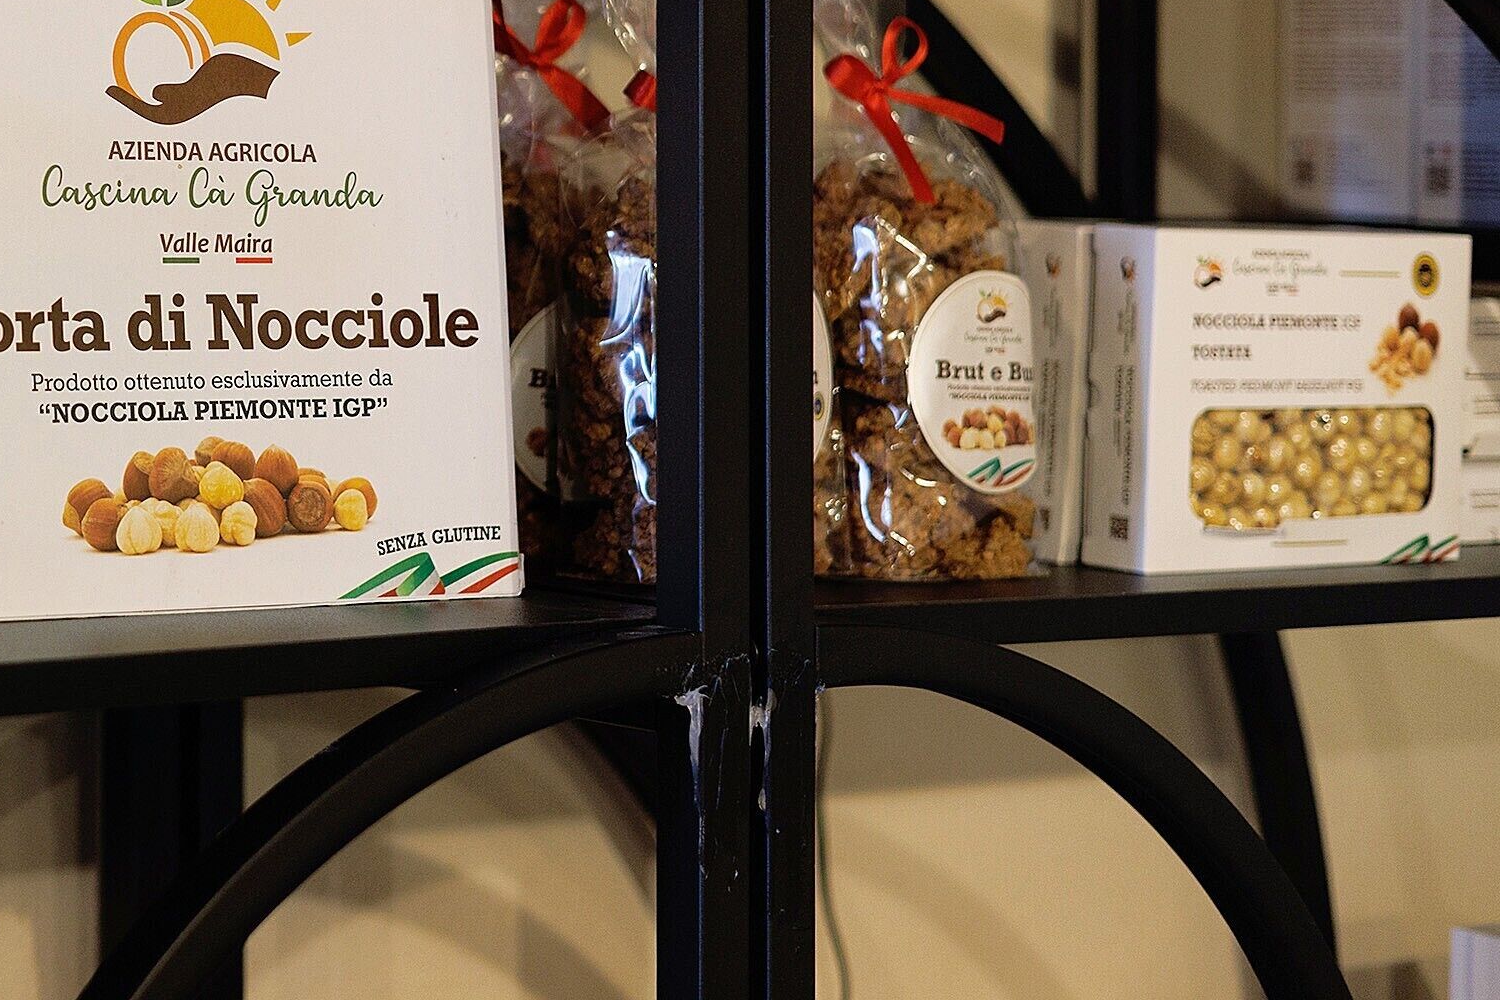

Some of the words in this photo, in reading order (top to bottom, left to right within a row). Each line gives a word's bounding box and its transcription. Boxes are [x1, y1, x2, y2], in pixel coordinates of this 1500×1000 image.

[107, 140, 204, 162] AZIENDA
[207, 142, 318, 163] AGRICOLA
[40, 163, 178, 210] Cascina
[186, 168, 235, 208] Cà
[241, 167, 385, 228] Granda
[159, 231, 210, 254] Valle
[214, 232, 273, 254] Maira
[127, 292, 192, 352] di
[205, 292, 480, 351] Nocciole
[1193, 313, 1265, 330] NOCCIOLA
[30, 372, 118, 392] Prodotto
[123, 372, 206, 391] ottenuto
[211, 369, 363, 390] esclusivamente
[368, 368, 394, 387] da
[935, 359, 984, 381] Brut
[990, 366, 1003, 381] e
[193, 398, 328, 421] PIEMONTE
[376, 531, 429, 556] SENZA
[431, 525, 501, 545] GLUTINE
